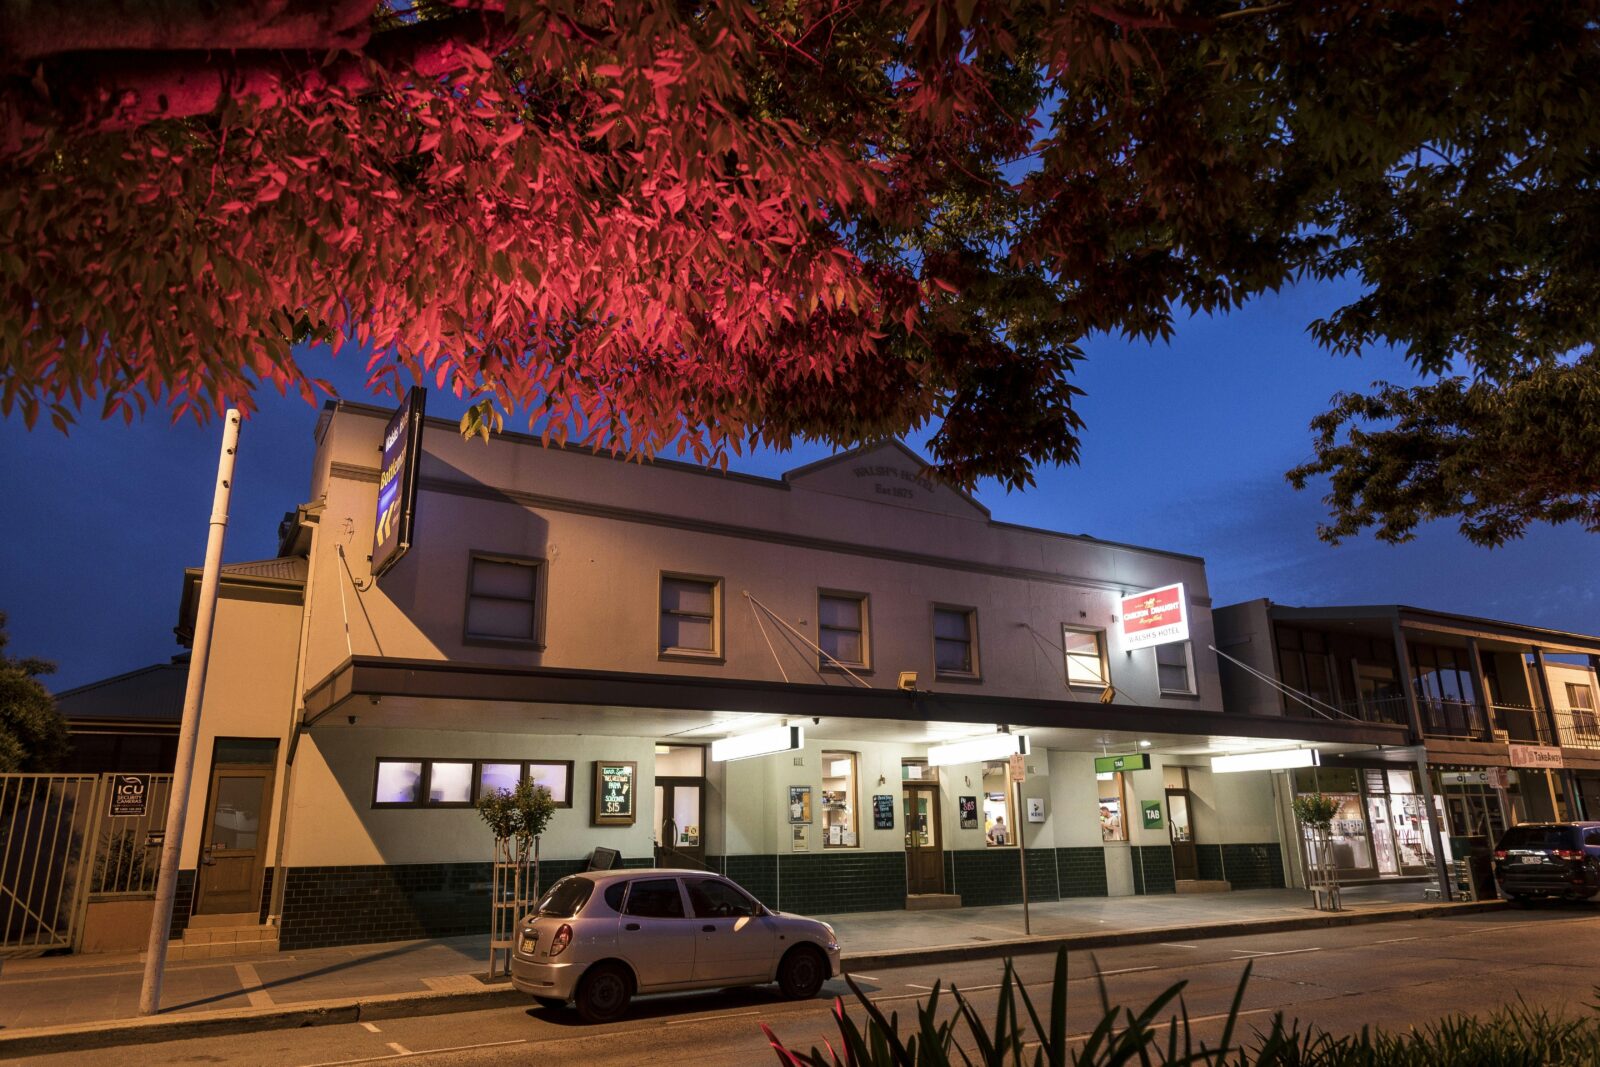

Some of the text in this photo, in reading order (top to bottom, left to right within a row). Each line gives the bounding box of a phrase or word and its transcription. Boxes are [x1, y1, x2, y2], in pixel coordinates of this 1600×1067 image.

[1159, 627, 1180, 637] HOTEL
[118, 785, 144, 795] ICU
[606, 801, 620, 813] $15
[1146, 810, 1160, 819] TAB
